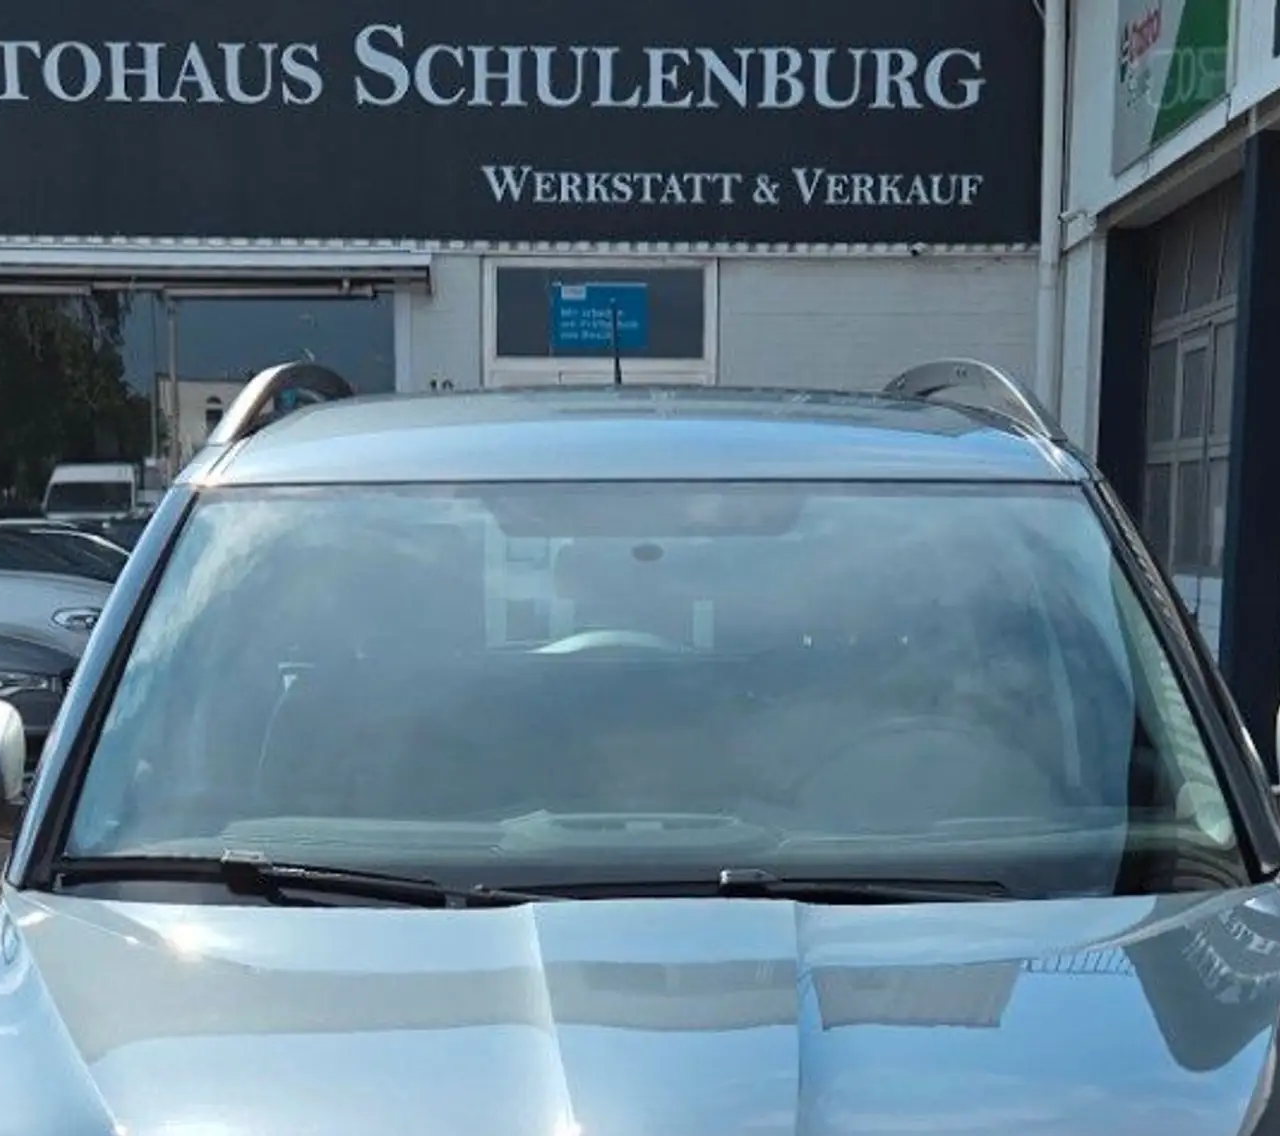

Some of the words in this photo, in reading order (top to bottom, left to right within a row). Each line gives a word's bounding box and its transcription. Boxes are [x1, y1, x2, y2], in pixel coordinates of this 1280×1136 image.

[354, 23, 985, 109] SCHULENBURG
[481, 165, 742, 204] WERKSTATT
[753, 174, 780, 204] &
[793, 167, 984, 205] VERKAUF
